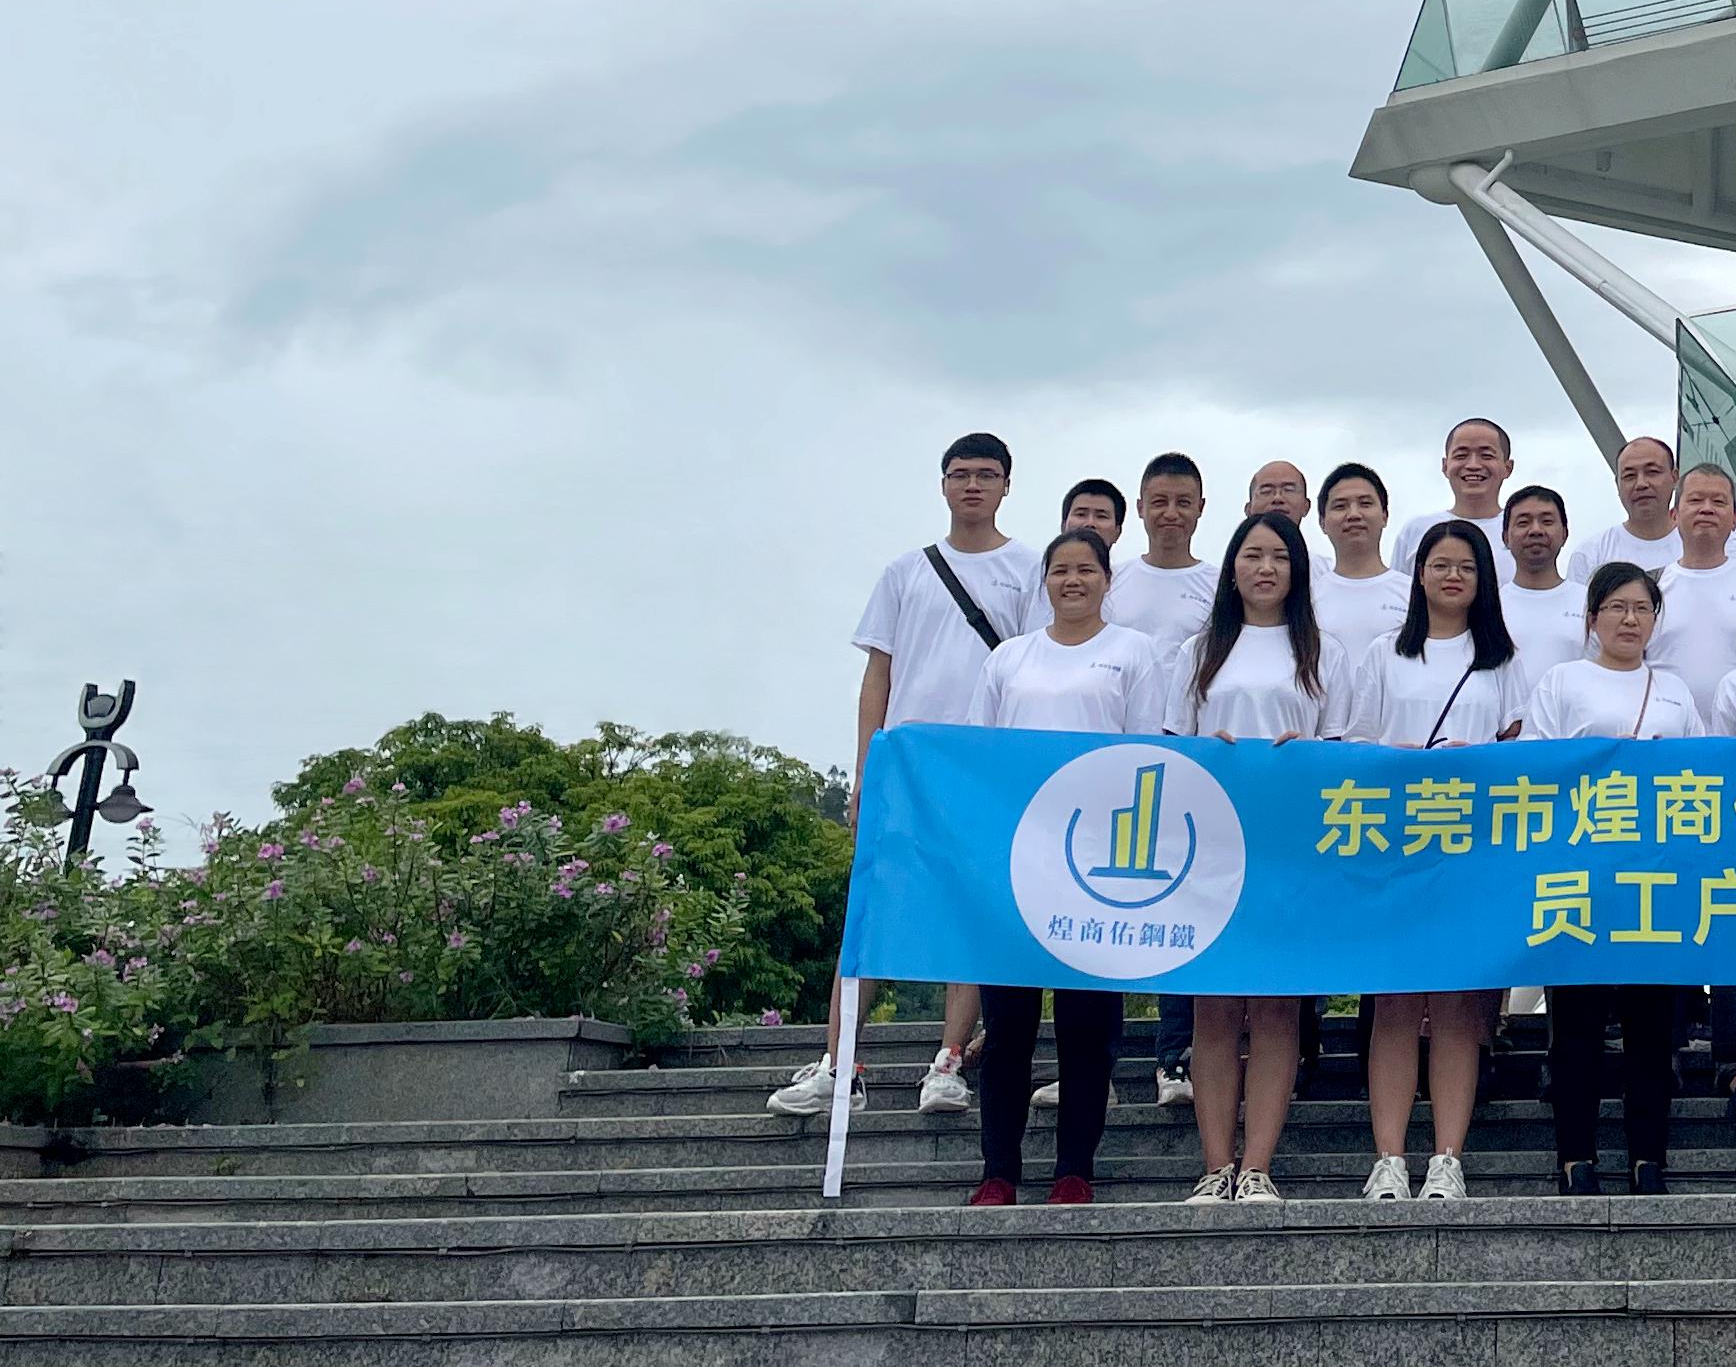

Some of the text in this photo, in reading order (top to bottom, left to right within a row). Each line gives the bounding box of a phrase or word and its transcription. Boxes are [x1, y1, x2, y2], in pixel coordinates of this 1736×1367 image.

[1047, 914, 1196, 950] 煌商佑鋼鐵
